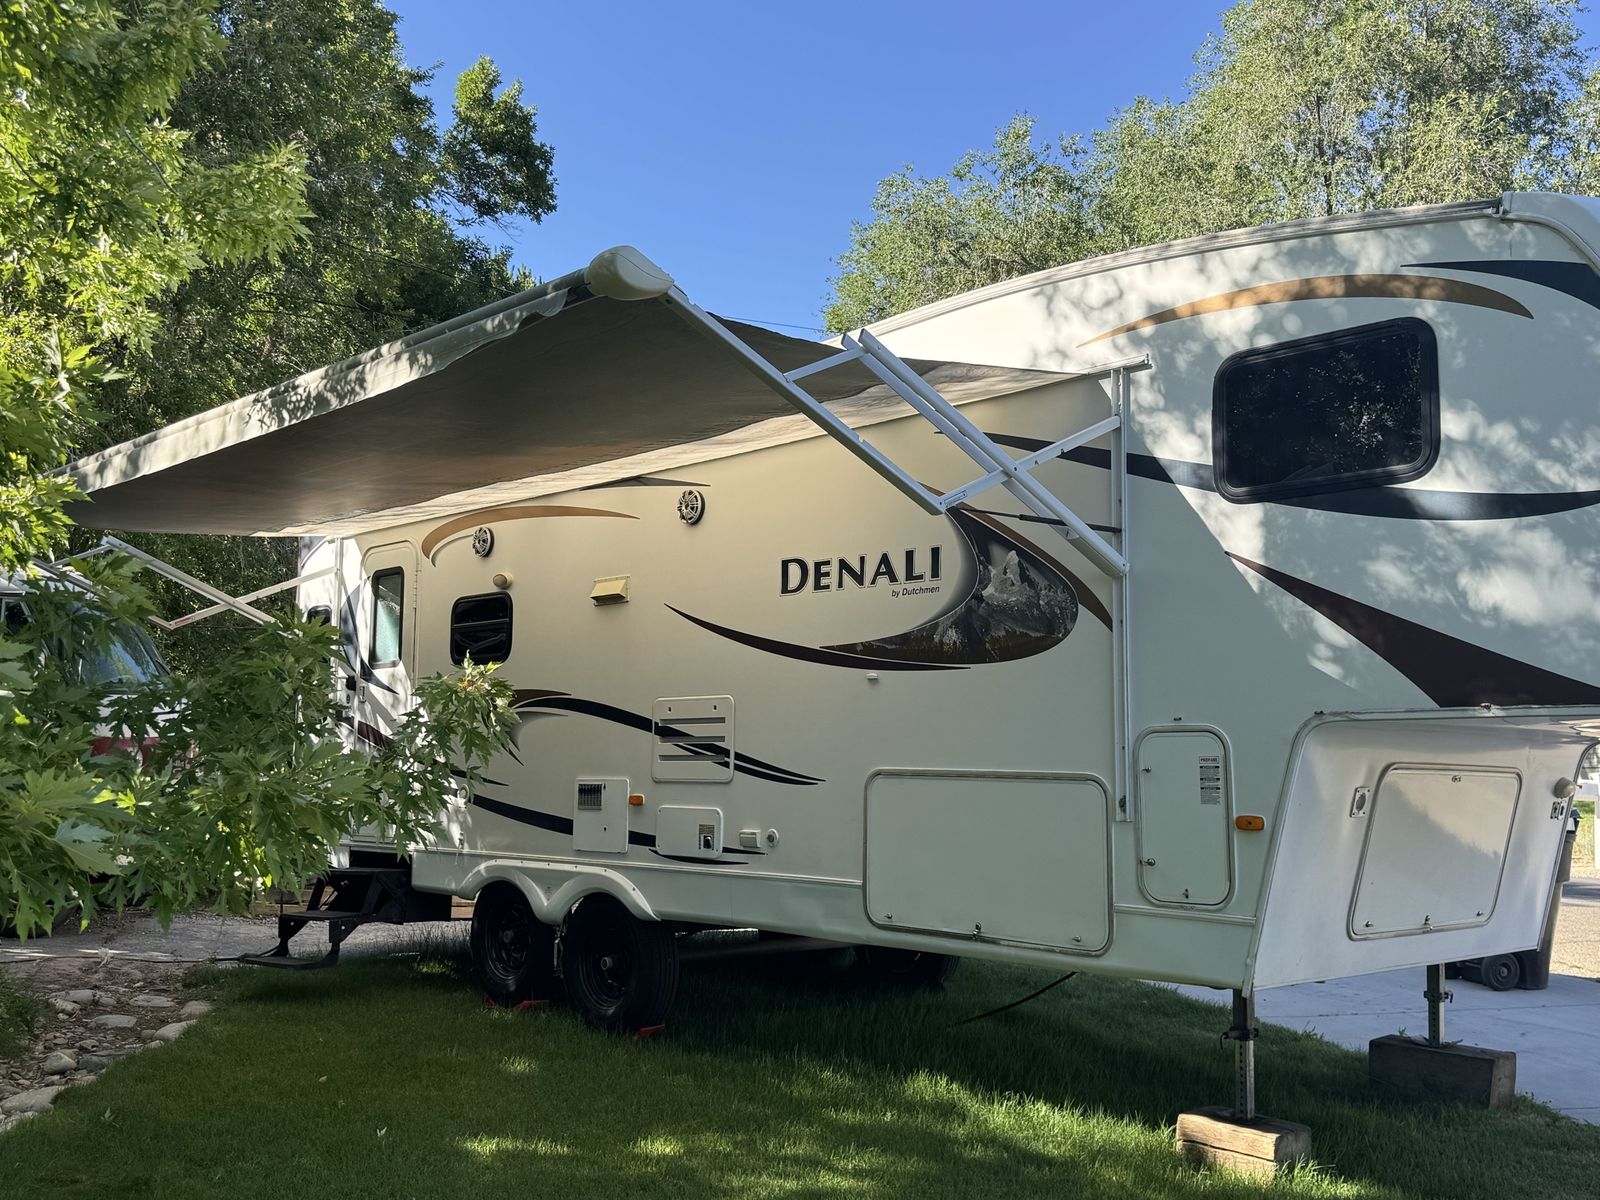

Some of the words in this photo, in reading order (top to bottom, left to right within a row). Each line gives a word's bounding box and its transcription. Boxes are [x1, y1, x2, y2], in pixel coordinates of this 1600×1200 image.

[780, 545, 942, 597] DENALI
[891, 589, 900, 598] by
[902, 586, 940, 596] Dutchmen
